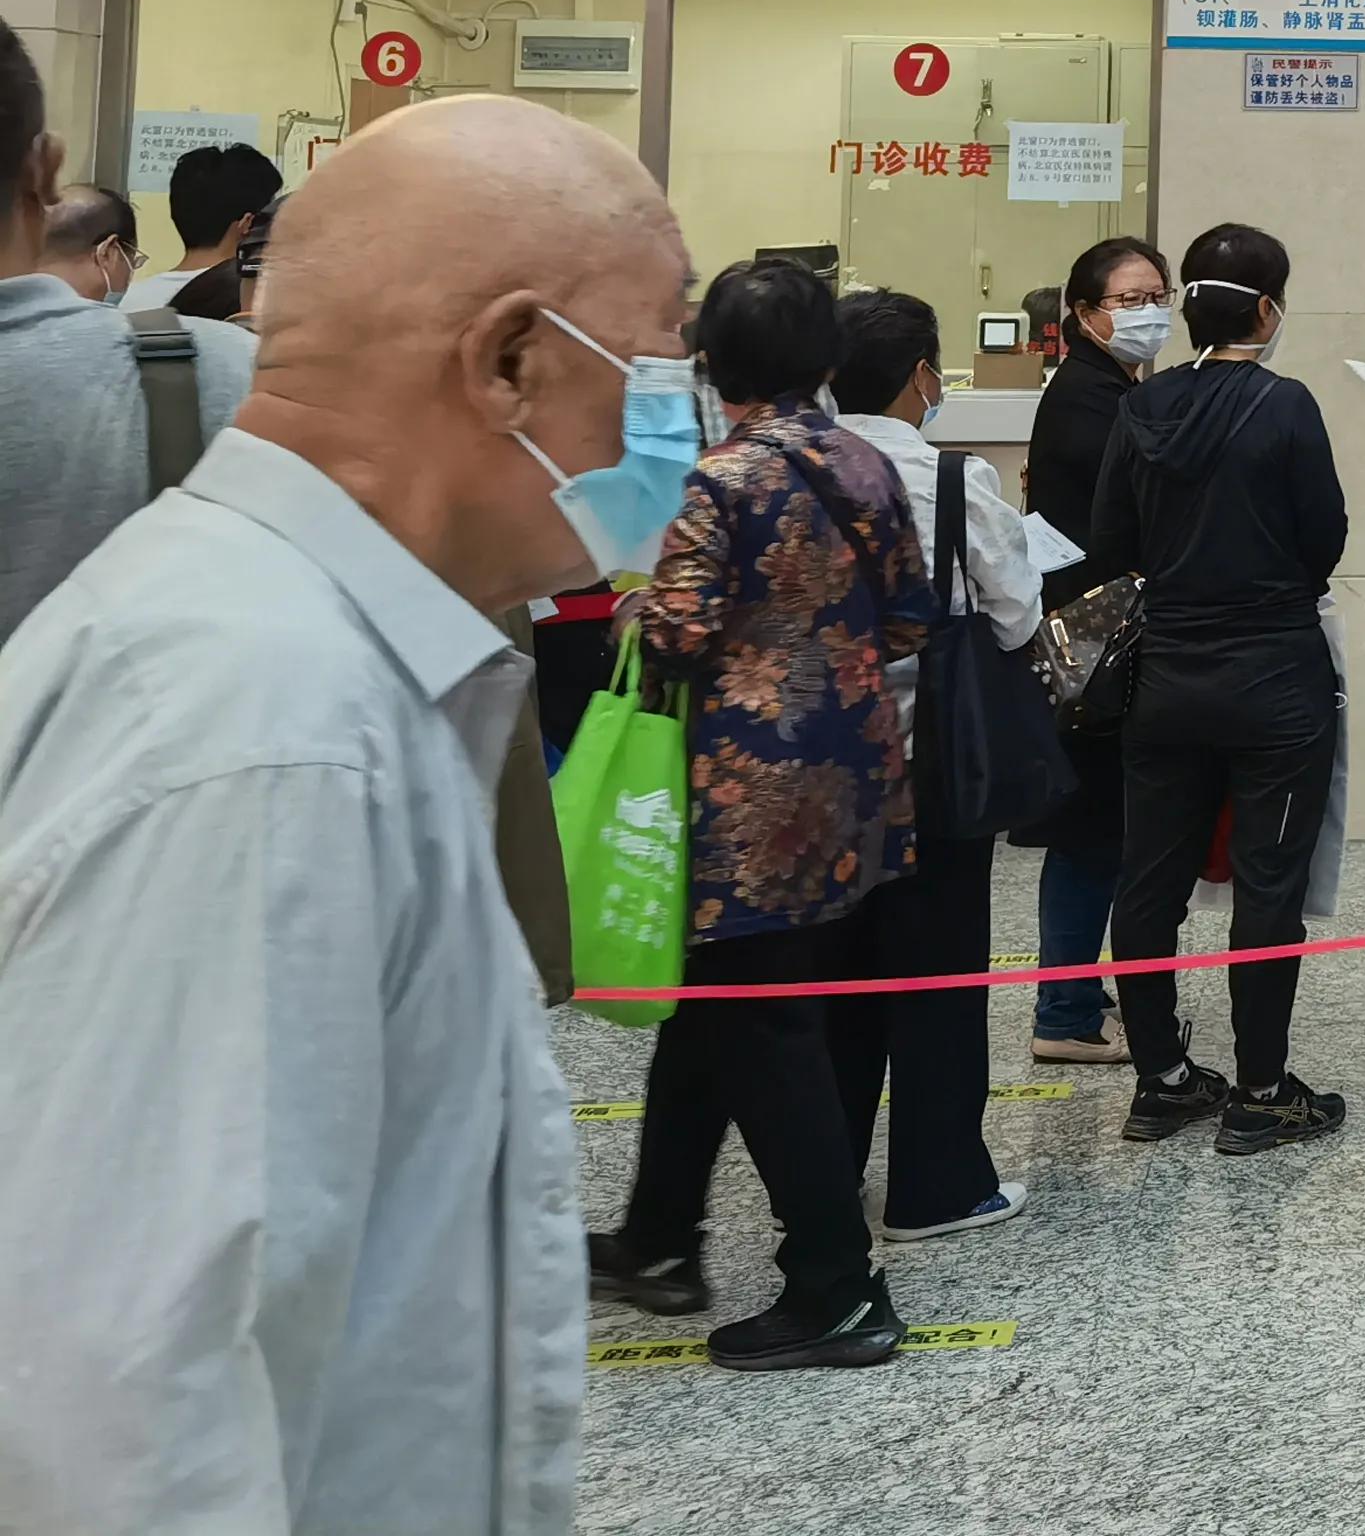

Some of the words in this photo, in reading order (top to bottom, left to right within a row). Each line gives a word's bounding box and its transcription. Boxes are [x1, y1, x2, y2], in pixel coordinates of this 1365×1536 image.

[377, 41, 405, 77] 6
[909, 53, 933, 87] 7
[1272, 59, 1334, 70] 民警提示
[1250, 74, 1353, 88] 保管好个人物品
[830, 140, 992, 177] 门诊收费
